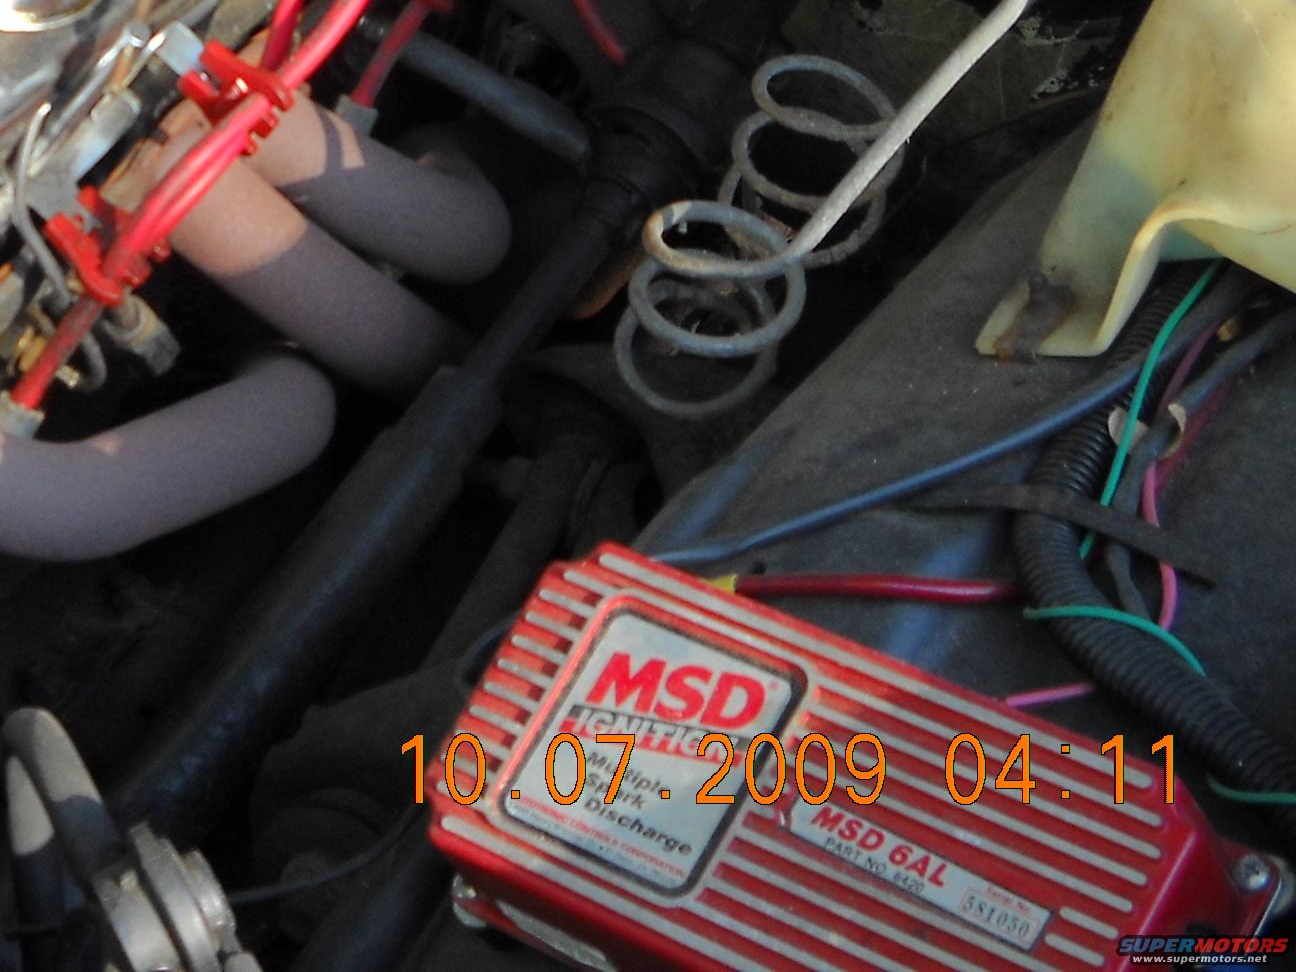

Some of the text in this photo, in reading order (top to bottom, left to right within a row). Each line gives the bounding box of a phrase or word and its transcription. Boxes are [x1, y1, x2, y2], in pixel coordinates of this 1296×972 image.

[585, 651, 766, 729] MSD
[584, 797, 692, 856] Discharge
[811, 806, 948, 889] MSD 6AL
[824, 837, 861, 864] PART
